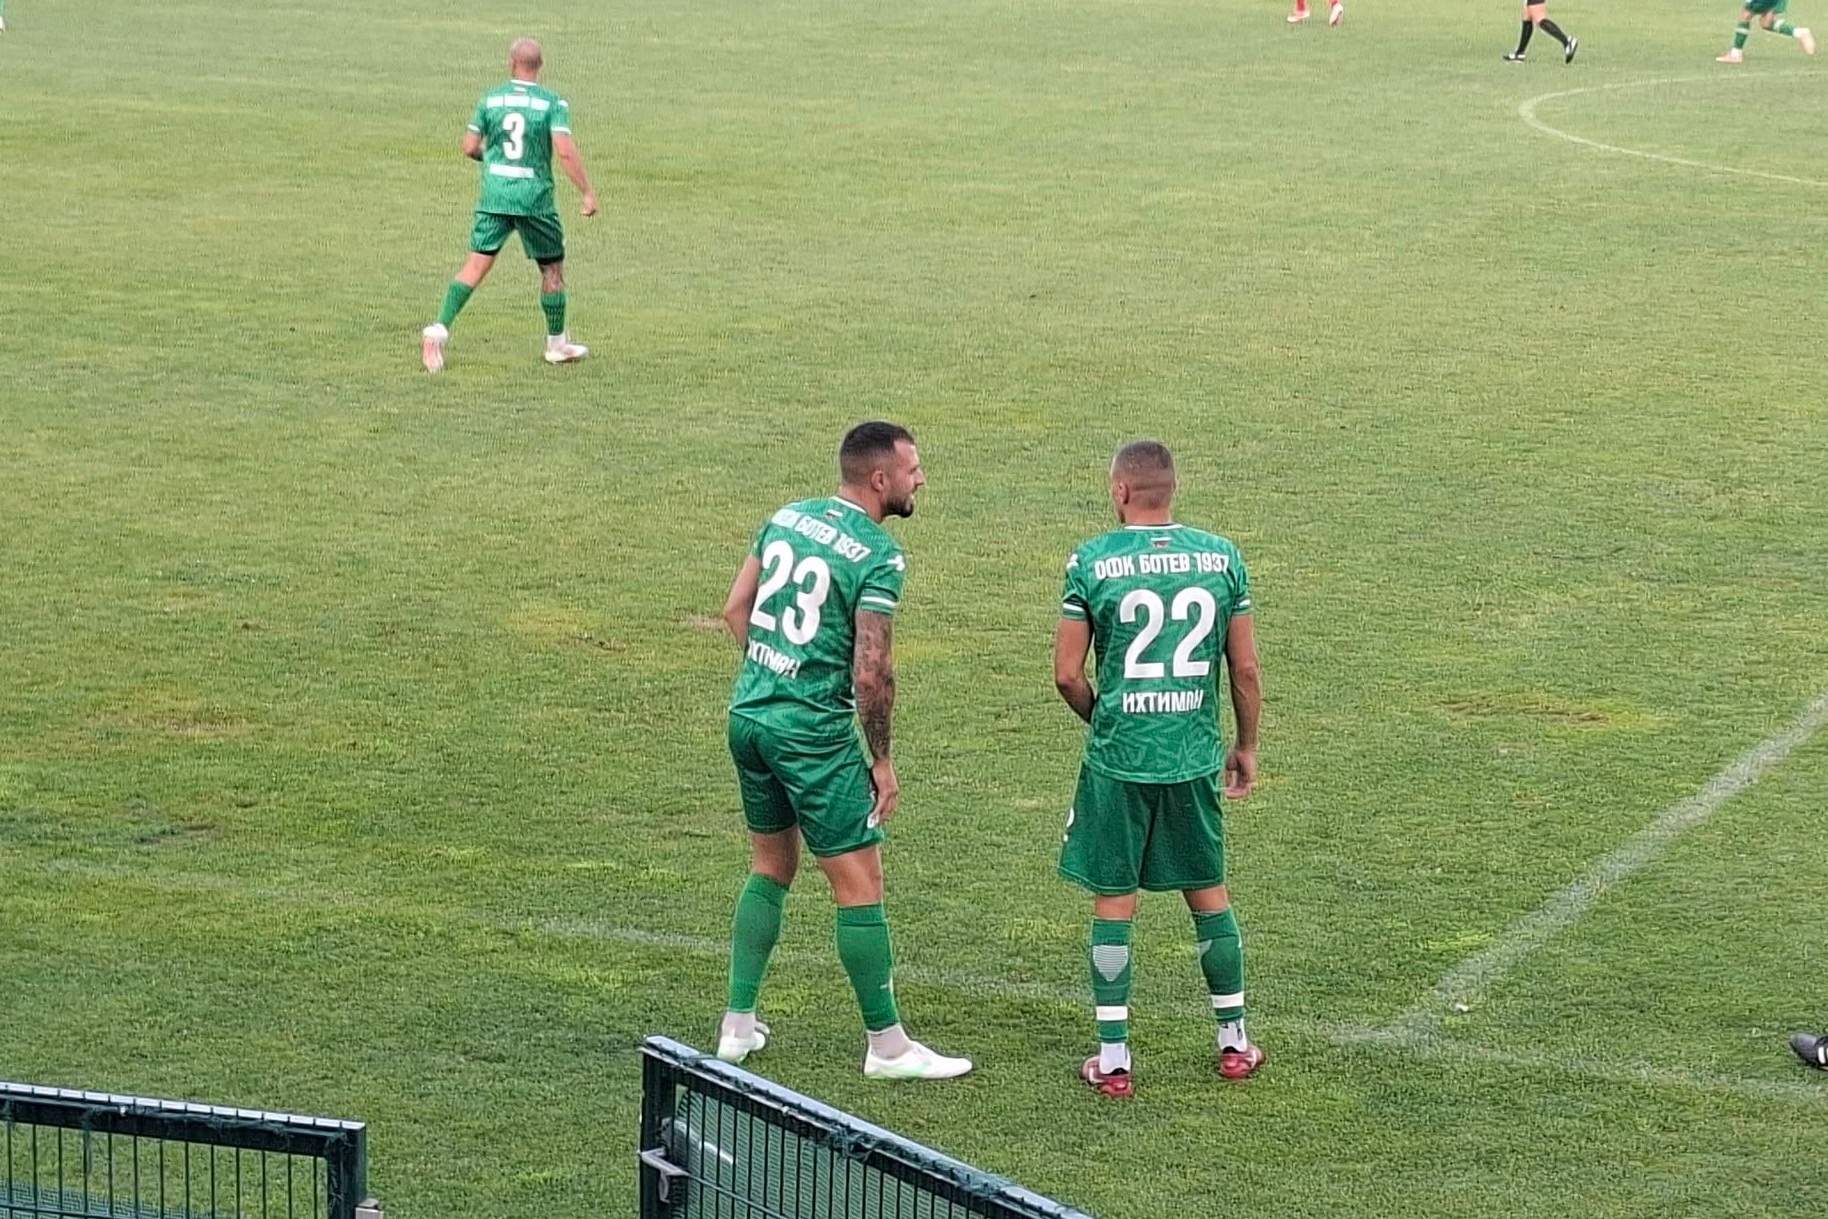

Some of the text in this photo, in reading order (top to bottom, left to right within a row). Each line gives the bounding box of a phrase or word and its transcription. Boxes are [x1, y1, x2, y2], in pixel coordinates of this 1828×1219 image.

[502, 112, 525, 160] 3
[833, 532, 872, 563] 1937
[1094, 551, 1230, 580] ОФК БОТЕВ 1937
[750, 540, 831, 645] 23
[1119, 586, 1217, 679] 22
